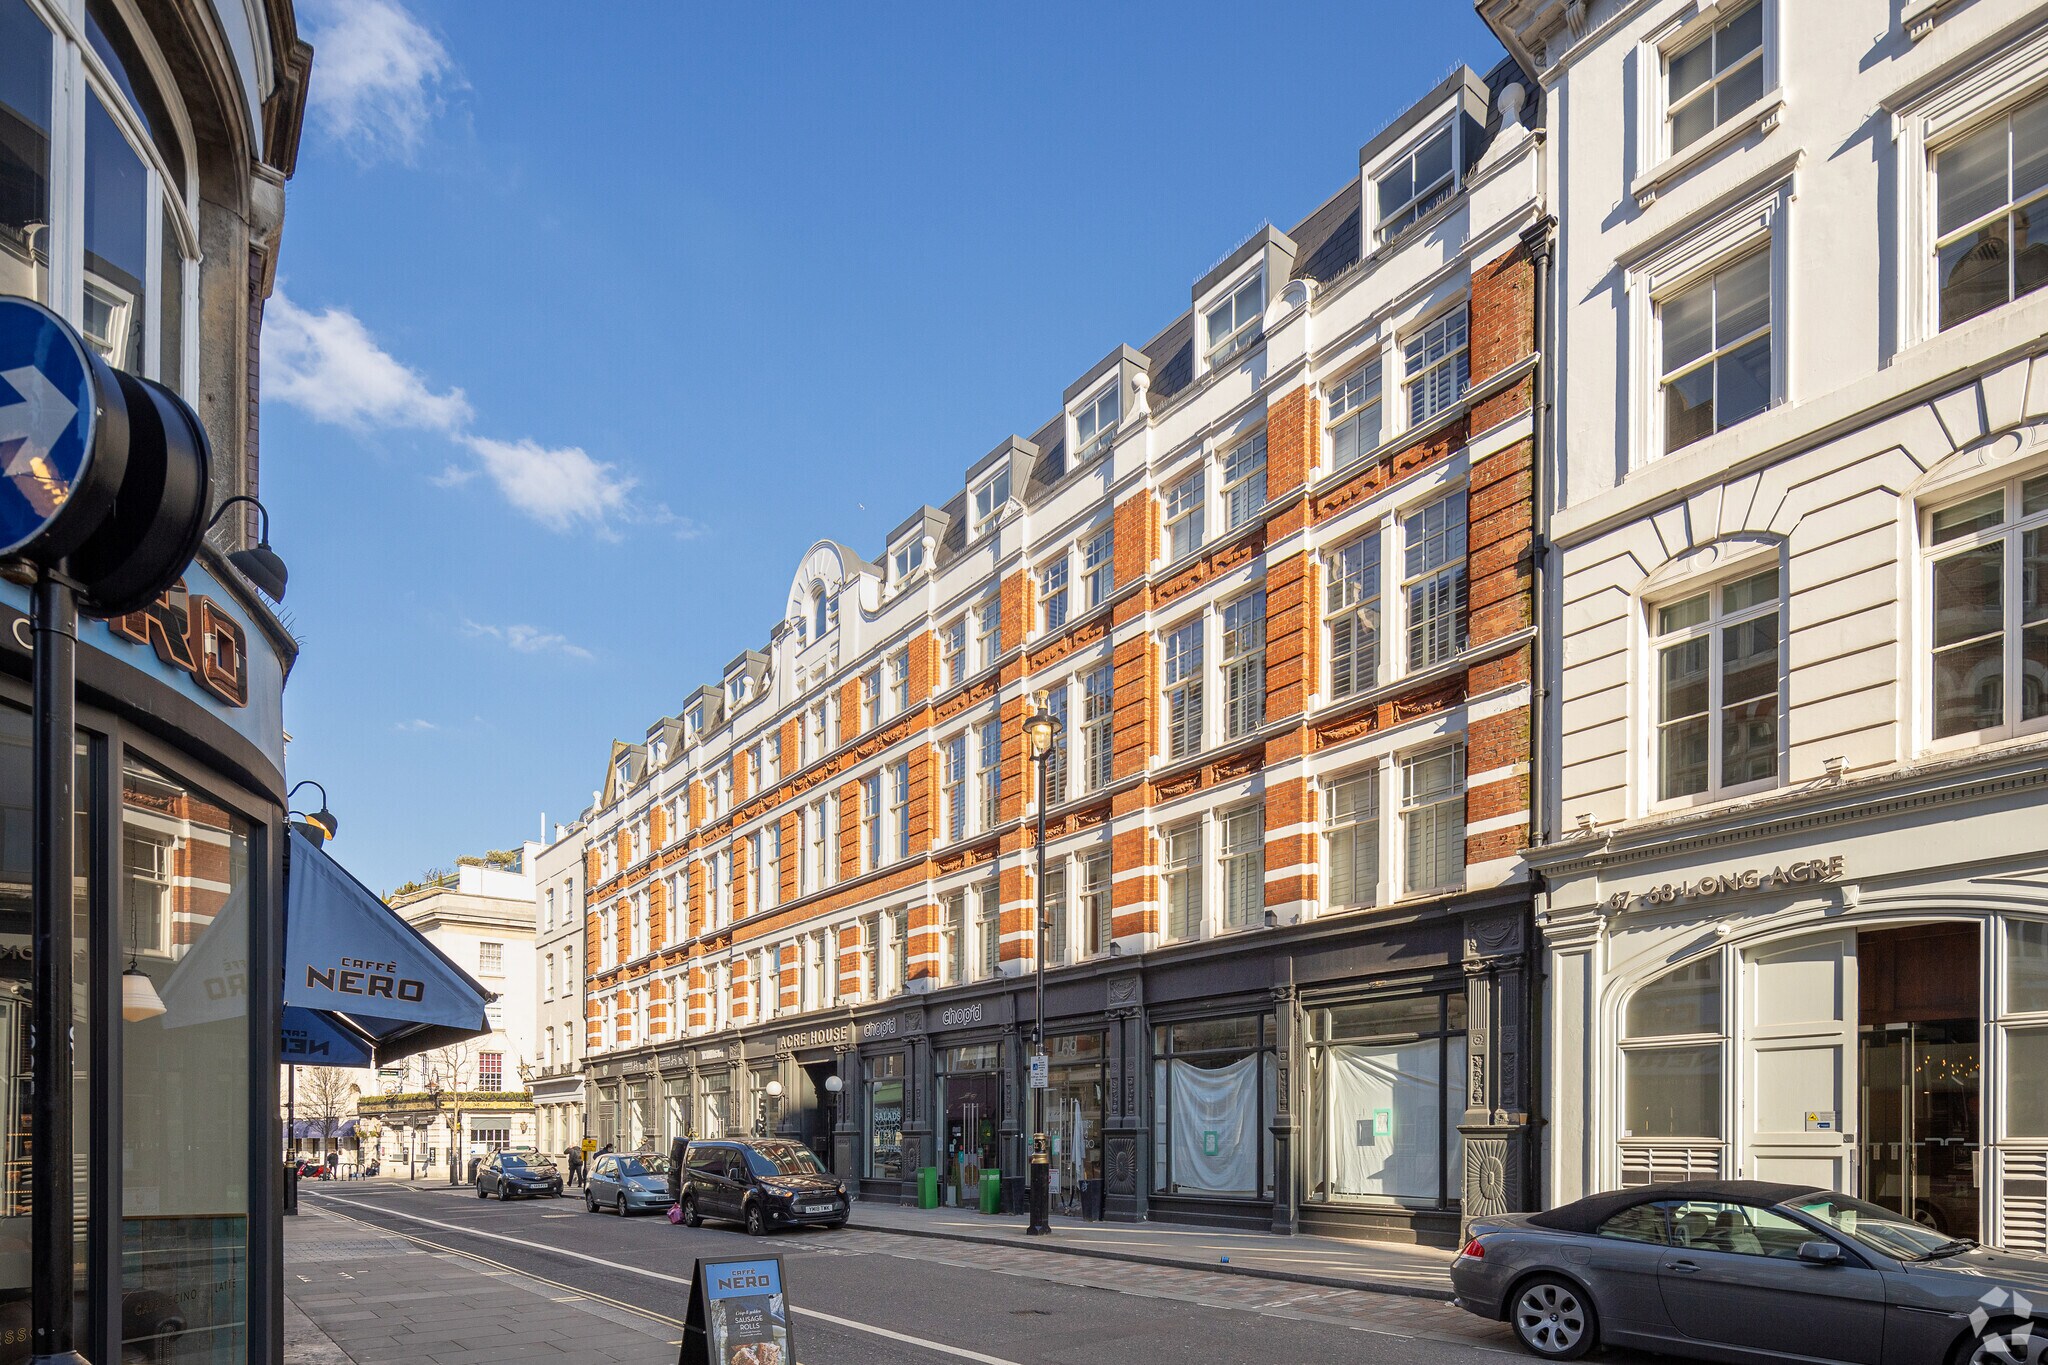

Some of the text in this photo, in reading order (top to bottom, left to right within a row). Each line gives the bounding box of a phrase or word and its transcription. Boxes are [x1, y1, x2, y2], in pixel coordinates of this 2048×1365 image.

[108, 575, 248, 708] RO
[1682, 868, 1761, 899] LONG
[1769, 854, 1846, 886] ACRE
[341, 957, 397, 973] CAFFÈ
[306, 964, 425, 1003] NERO
[942, 1003, 982, 1026] chop'd
[780, 1025, 848, 1050] ACRE HOUSE
[863, 1017, 897, 1038] chop'd
[718, 1275, 770, 1290] NERO
[732, 1268, 756, 1276] CAFFÈ
[215, 1278, 236, 1293] LATTE
[735, 1315, 763, 1323] SAUSAGE
